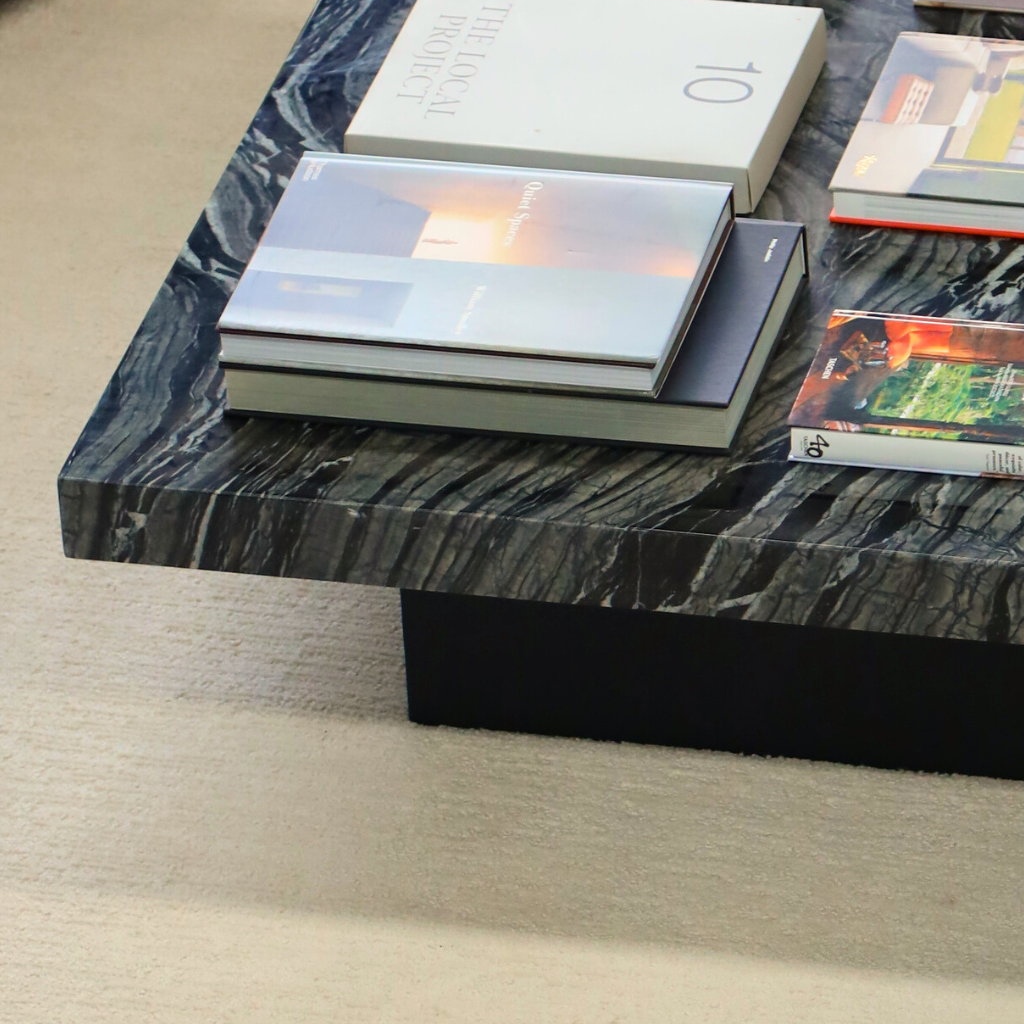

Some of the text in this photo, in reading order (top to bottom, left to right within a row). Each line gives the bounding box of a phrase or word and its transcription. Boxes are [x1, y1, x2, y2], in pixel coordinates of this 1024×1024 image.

[395, 14, 467, 104] PROJECT
[422, 2, 512, 119] THE LOCAL
[682, 61, 763, 104] 10
[502, 180, 544, 246] Quiet Spaces
[821, 357, 837, 379] TASCHEN
[806, 433, 830, 459] 40
